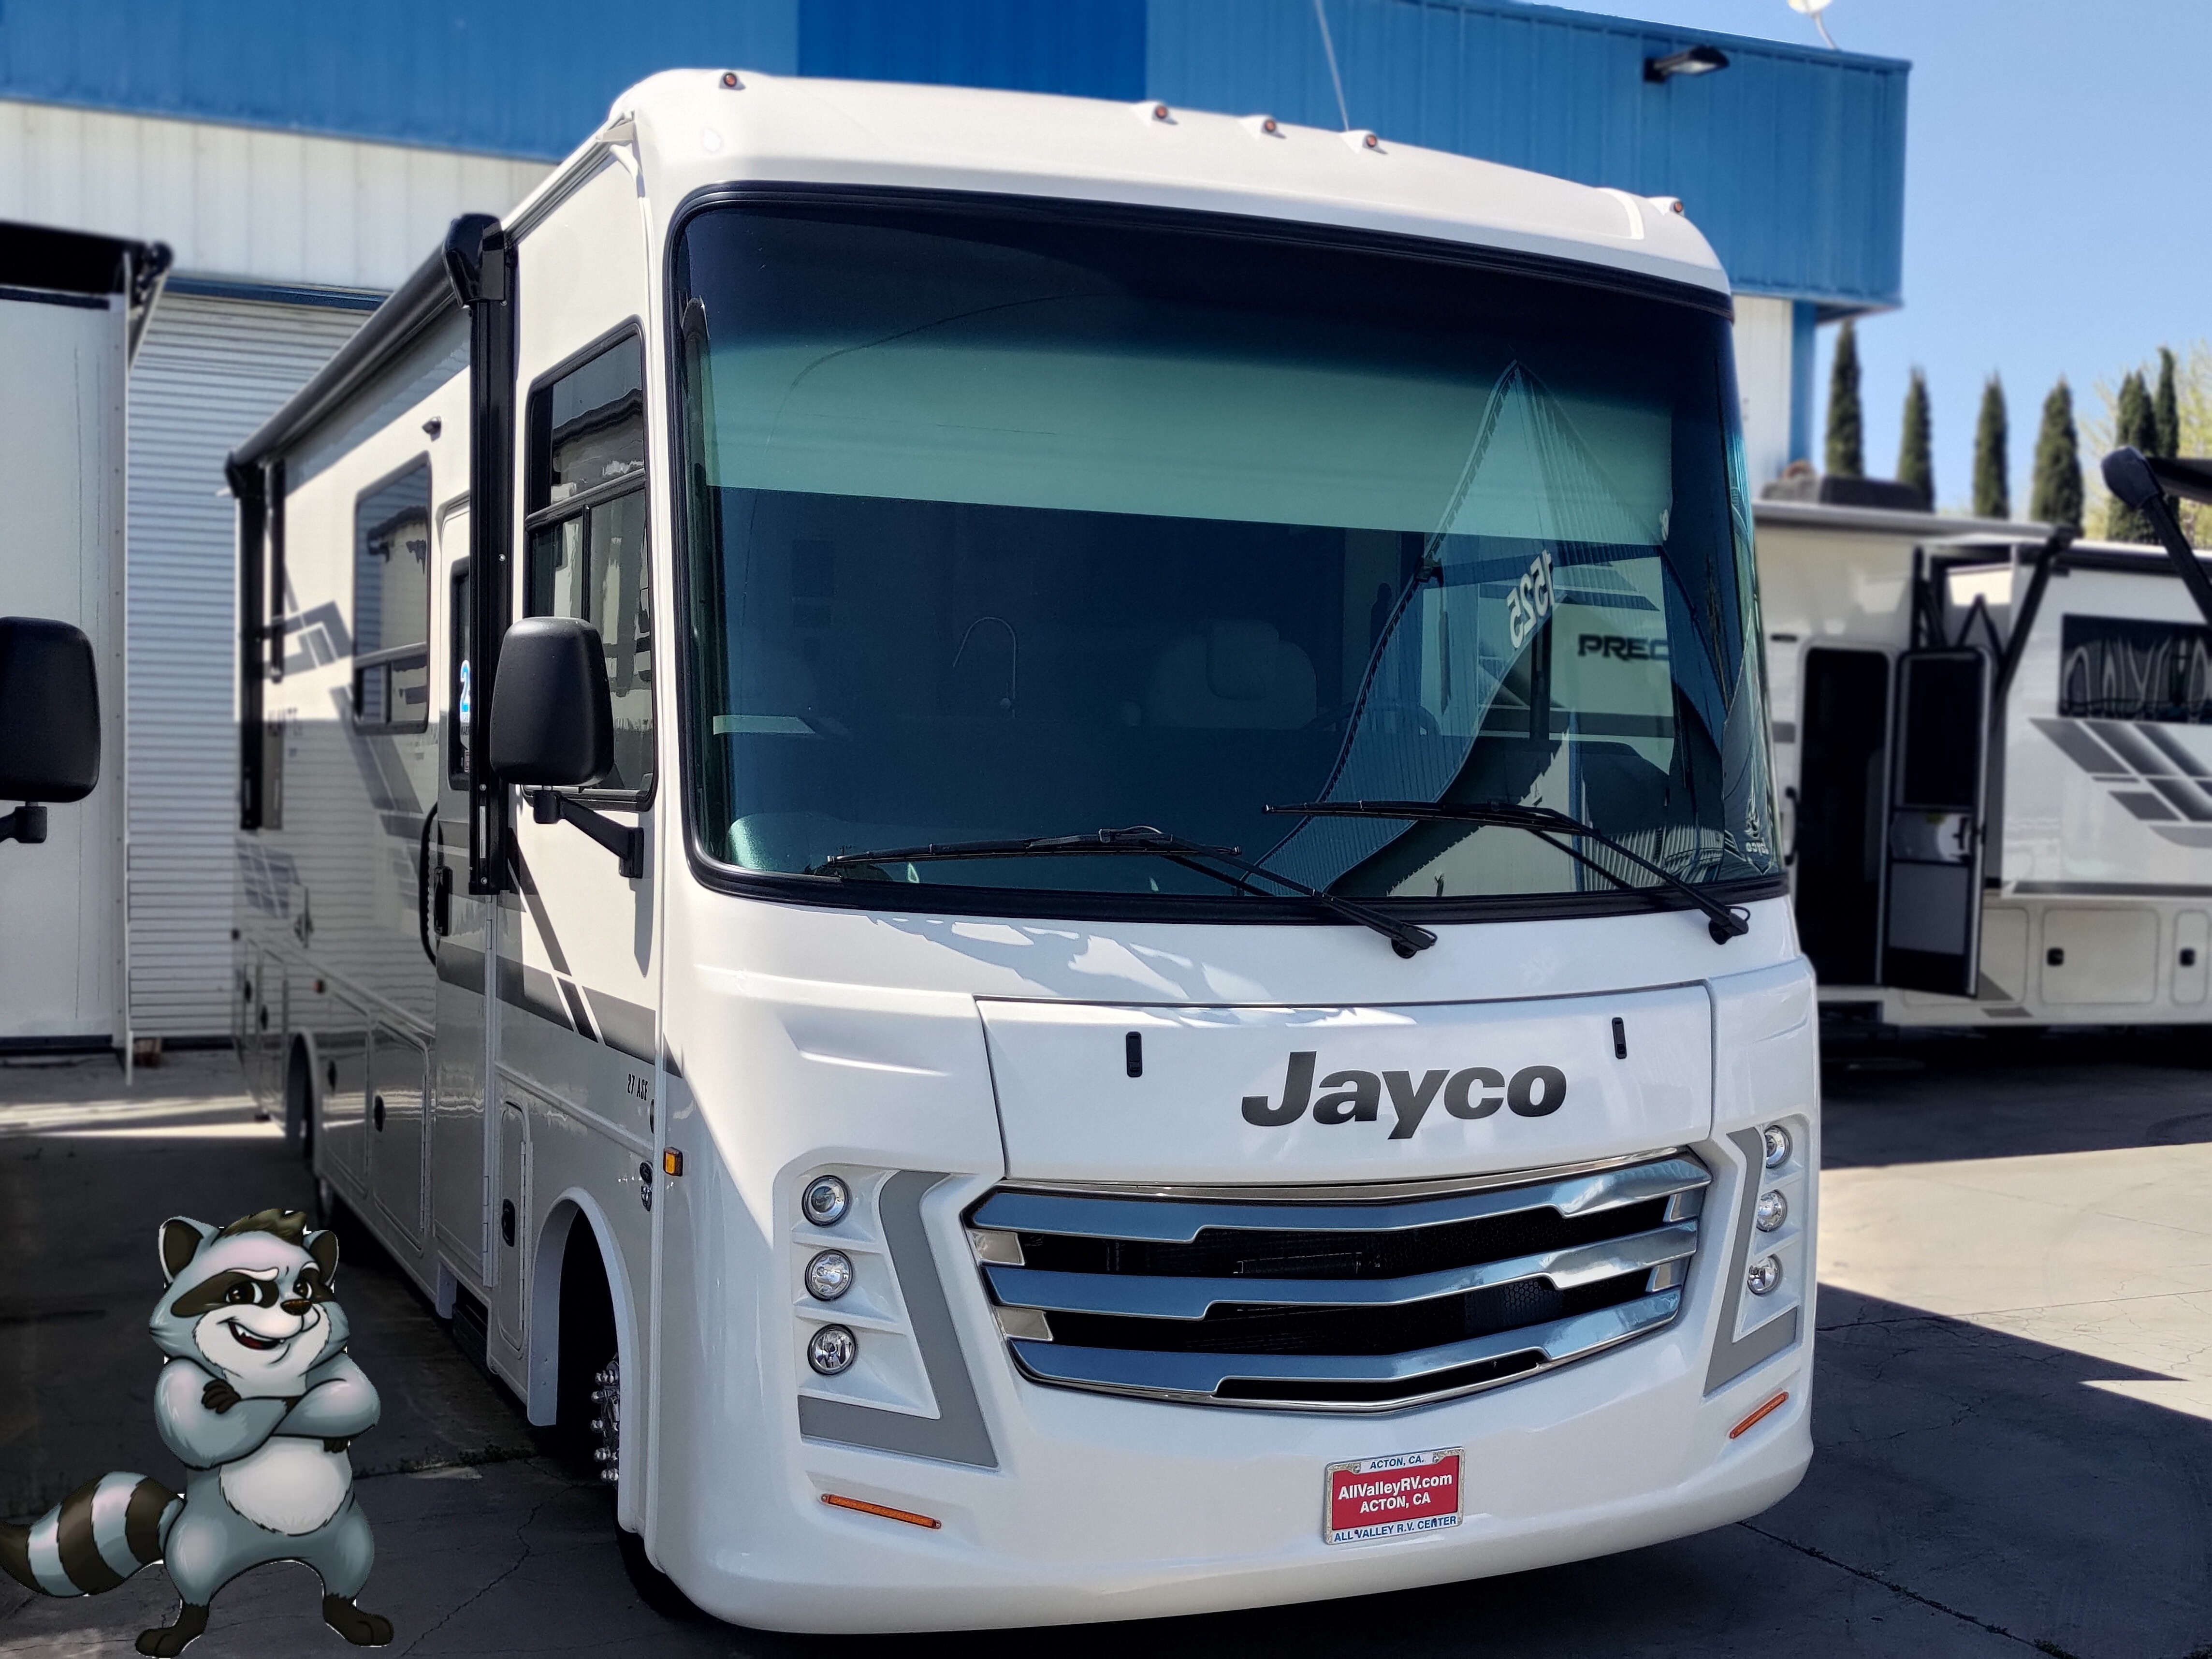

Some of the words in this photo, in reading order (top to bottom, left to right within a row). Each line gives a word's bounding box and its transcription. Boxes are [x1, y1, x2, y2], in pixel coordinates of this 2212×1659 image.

[627, 1074, 635, 1094] 27
[1242, 1051, 1567, 1140] Jayco
[1370, 1459, 1406, 1470] ACTON,
[1409, 1455, 1424, 1464] CA.
[1338, 1474, 1452, 1499] AllValleyRV.com
[1360, 1496, 1409, 1513] ACTON,
[1413, 1492, 1431, 1505] CA
[1334, 1533, 1353, 1542] ALL
[1356, 1525, 1394, 1539] VALLEY
[1397, 1523, 1414, 1533] R.V.
[1417, 1516, 1456, 1529] CENTER
